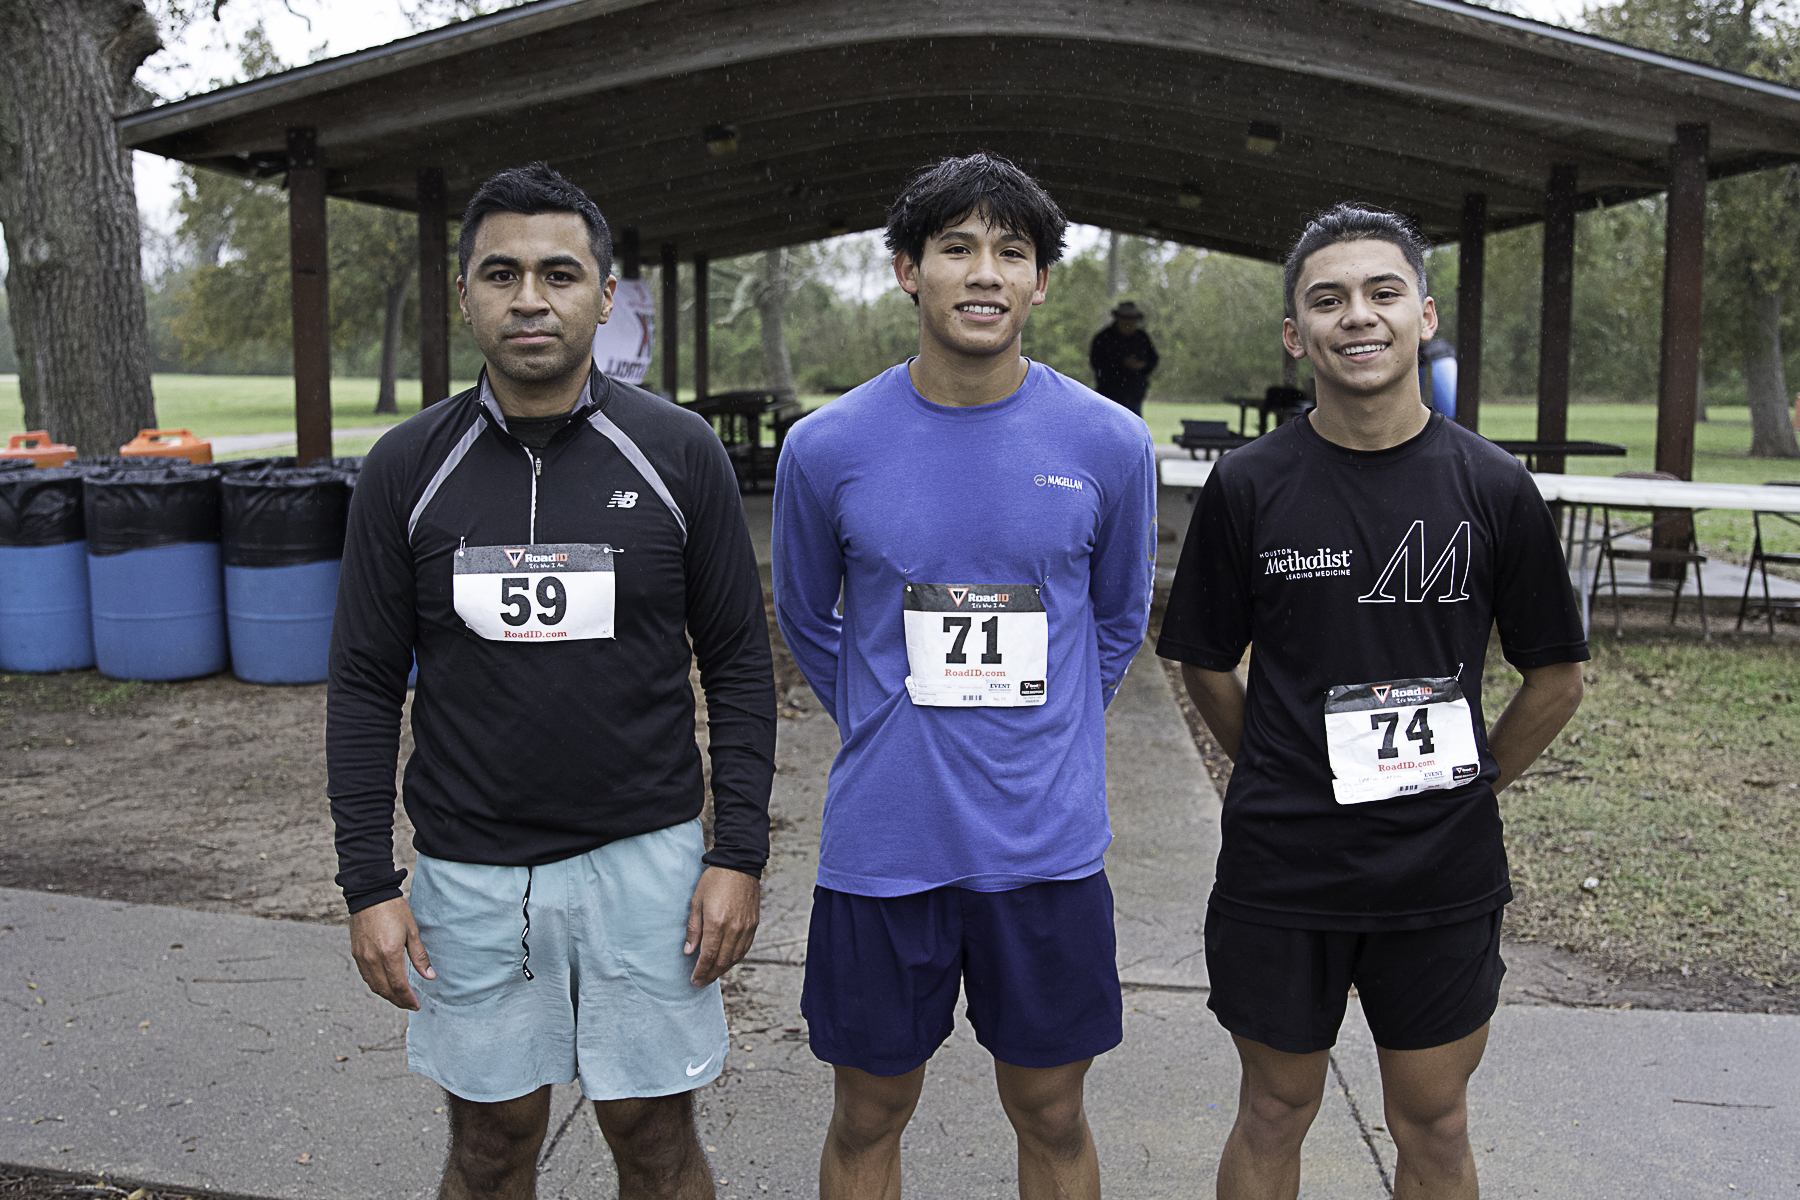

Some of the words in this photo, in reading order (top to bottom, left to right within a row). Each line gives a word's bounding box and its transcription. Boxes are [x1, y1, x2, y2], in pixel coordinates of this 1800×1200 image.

[1048, 475, 1082, 490] MAGELLAN
[525, 553, 568, 562] RoadID
[1260, 549, 1292, 558] HOUSTON
[1265, 548, 1350, 575] Methodist
[1358, 520, 1470, 603] M
[1286, 572, 1312, 580] LEADING
[1315, 570, 1350, 578] MEDICINE
[500, 576, 567, 626] 59
[968, 594, 1009, 602] RoadID
[943, 616, 1002, 664] 71
[945, 669, 1006, 677] RoadID.com
[1392, 687, 1432, 698] RoadID
[1370, 708, 1435, 759] 74
[1378, 760, 1435, 772] RoadID.com
